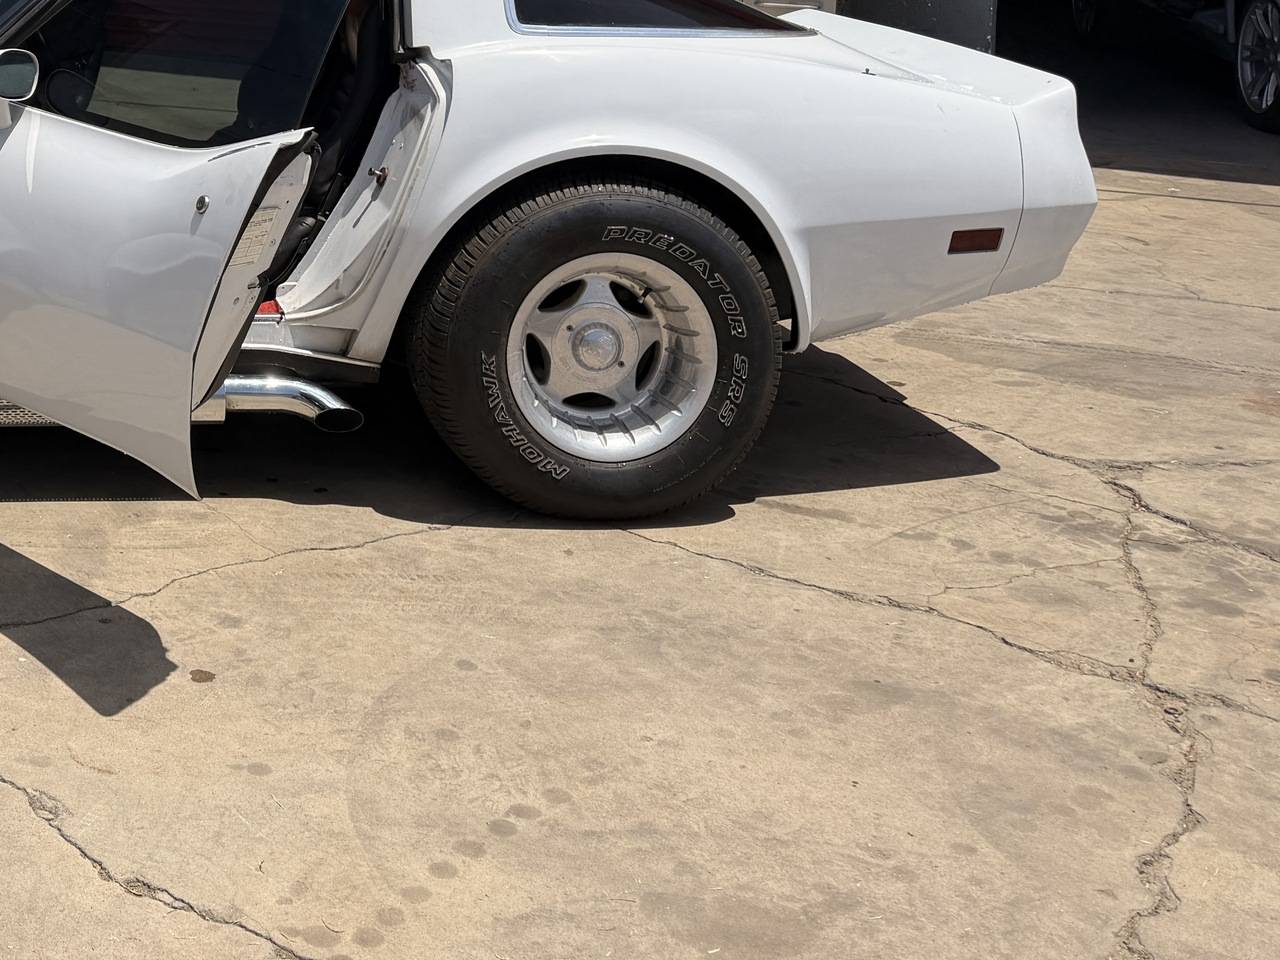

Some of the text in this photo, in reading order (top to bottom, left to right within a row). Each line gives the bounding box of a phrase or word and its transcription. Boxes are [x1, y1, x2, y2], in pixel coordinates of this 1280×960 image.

[601, 225, 748, 428] PREDATOR SRS
[479, 350, 570, 480] MOHAWK
